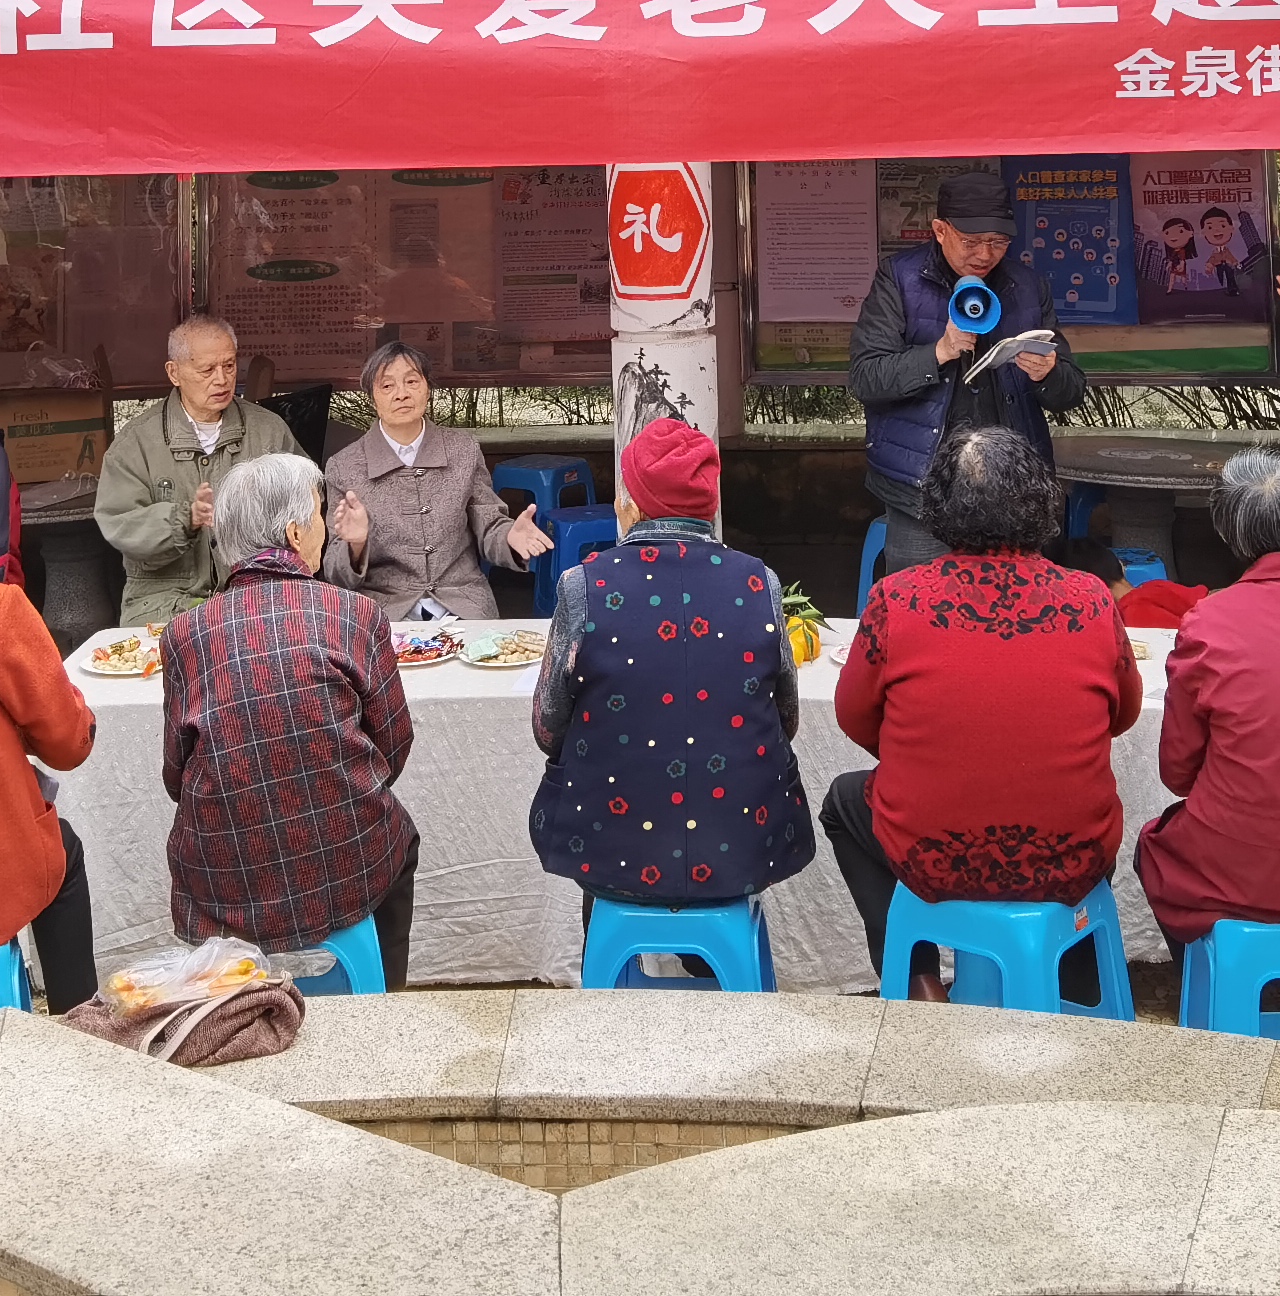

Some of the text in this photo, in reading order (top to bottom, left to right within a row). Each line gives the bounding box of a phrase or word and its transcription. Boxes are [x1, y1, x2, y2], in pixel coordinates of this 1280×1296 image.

[1016, 169, 1117, 184] 人口普查家家参与
[1142, 169, 1251, 185] 人口普查大点名
[619, 203, 683, 253] 礼
[13, 409, 49, 422] Fresh
